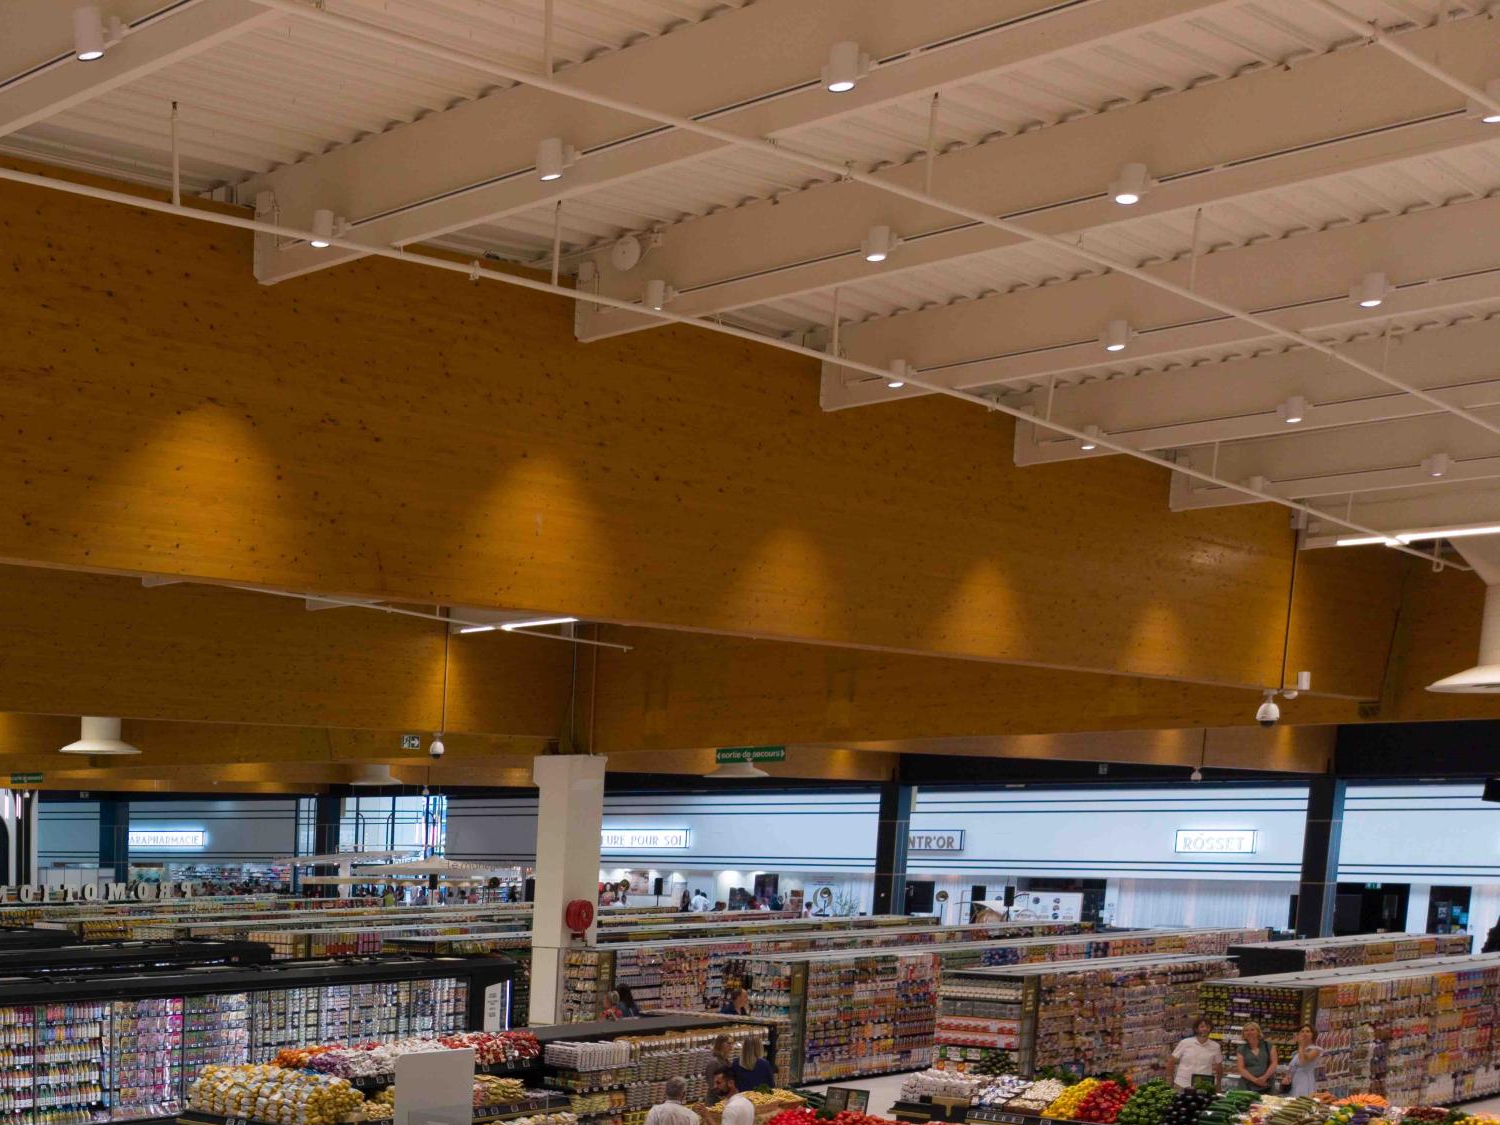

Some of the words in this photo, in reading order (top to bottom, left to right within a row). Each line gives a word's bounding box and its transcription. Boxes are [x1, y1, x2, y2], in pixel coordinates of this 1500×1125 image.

[752, 750, 781, 758] secours
[129, 835, 200, 845] ARAPHARMACIE
[630, 835, 659, 846] POUR
[663, 835, 682, 846] SOI
